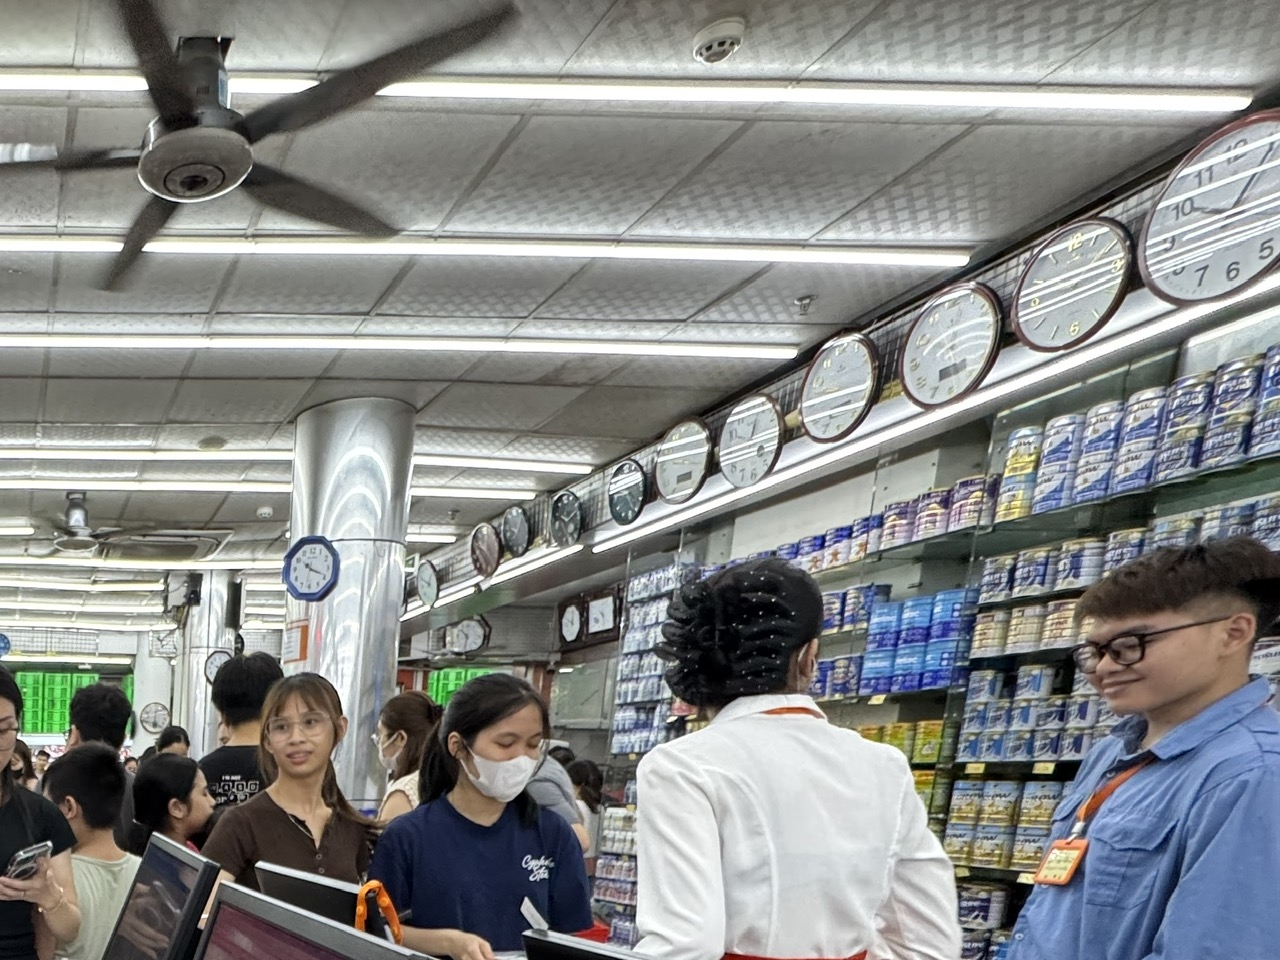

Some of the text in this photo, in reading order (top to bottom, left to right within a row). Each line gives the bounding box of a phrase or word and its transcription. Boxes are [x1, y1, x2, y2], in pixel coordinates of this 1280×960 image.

[1194, 165, 1214, 187] 11
[1171, 197, 1194, 221] 10
[1258, 237, 1274, 260] 5
[1194, 265, 1209, 287] 7
[1226, 261, 1240, 281] 6
[1069, 322, 1080, 336] 6
